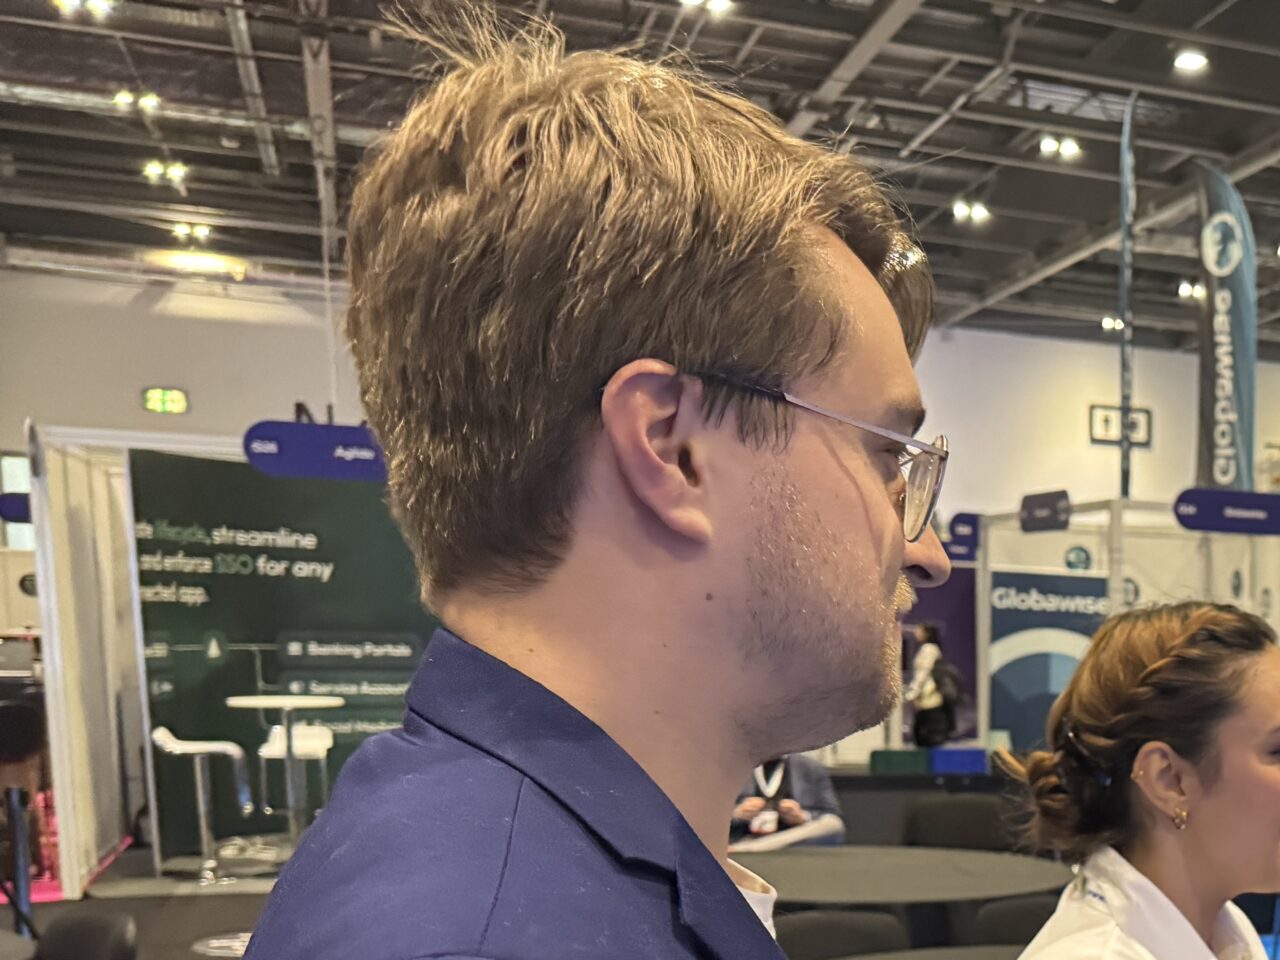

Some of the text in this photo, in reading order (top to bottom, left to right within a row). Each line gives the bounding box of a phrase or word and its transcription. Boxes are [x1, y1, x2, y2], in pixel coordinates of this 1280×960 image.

[211, 525, 318, 550] streamline
[256, 553, 289, 577] for
[292, 561, 334, 583] any
